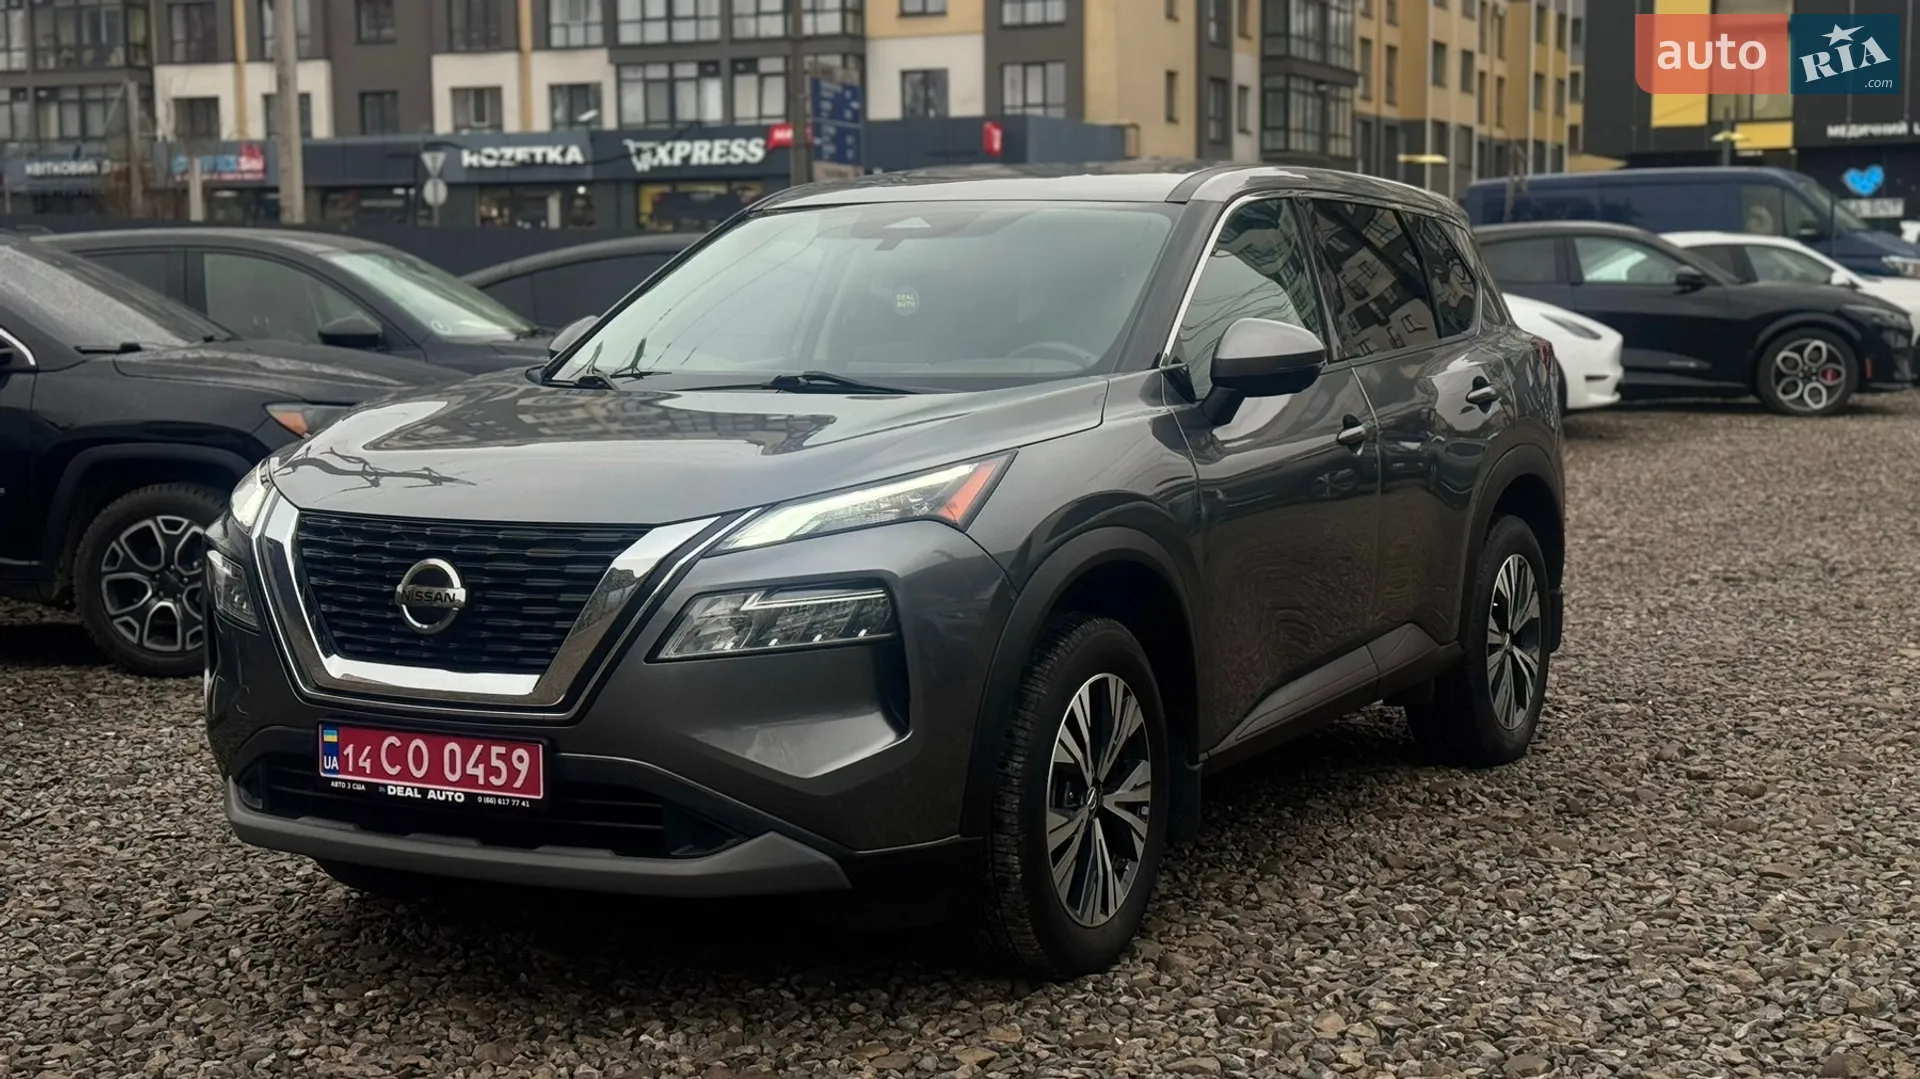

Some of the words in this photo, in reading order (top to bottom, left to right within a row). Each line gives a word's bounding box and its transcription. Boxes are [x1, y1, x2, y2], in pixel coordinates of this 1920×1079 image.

[402, 590, 456, 603] NISSAN
[323, 755, 339, 771] UA
[443, 742, 531, 789] 0459
[387, 785, 422, 798] DEAL
[427, 789, 465, 803] AUTO
